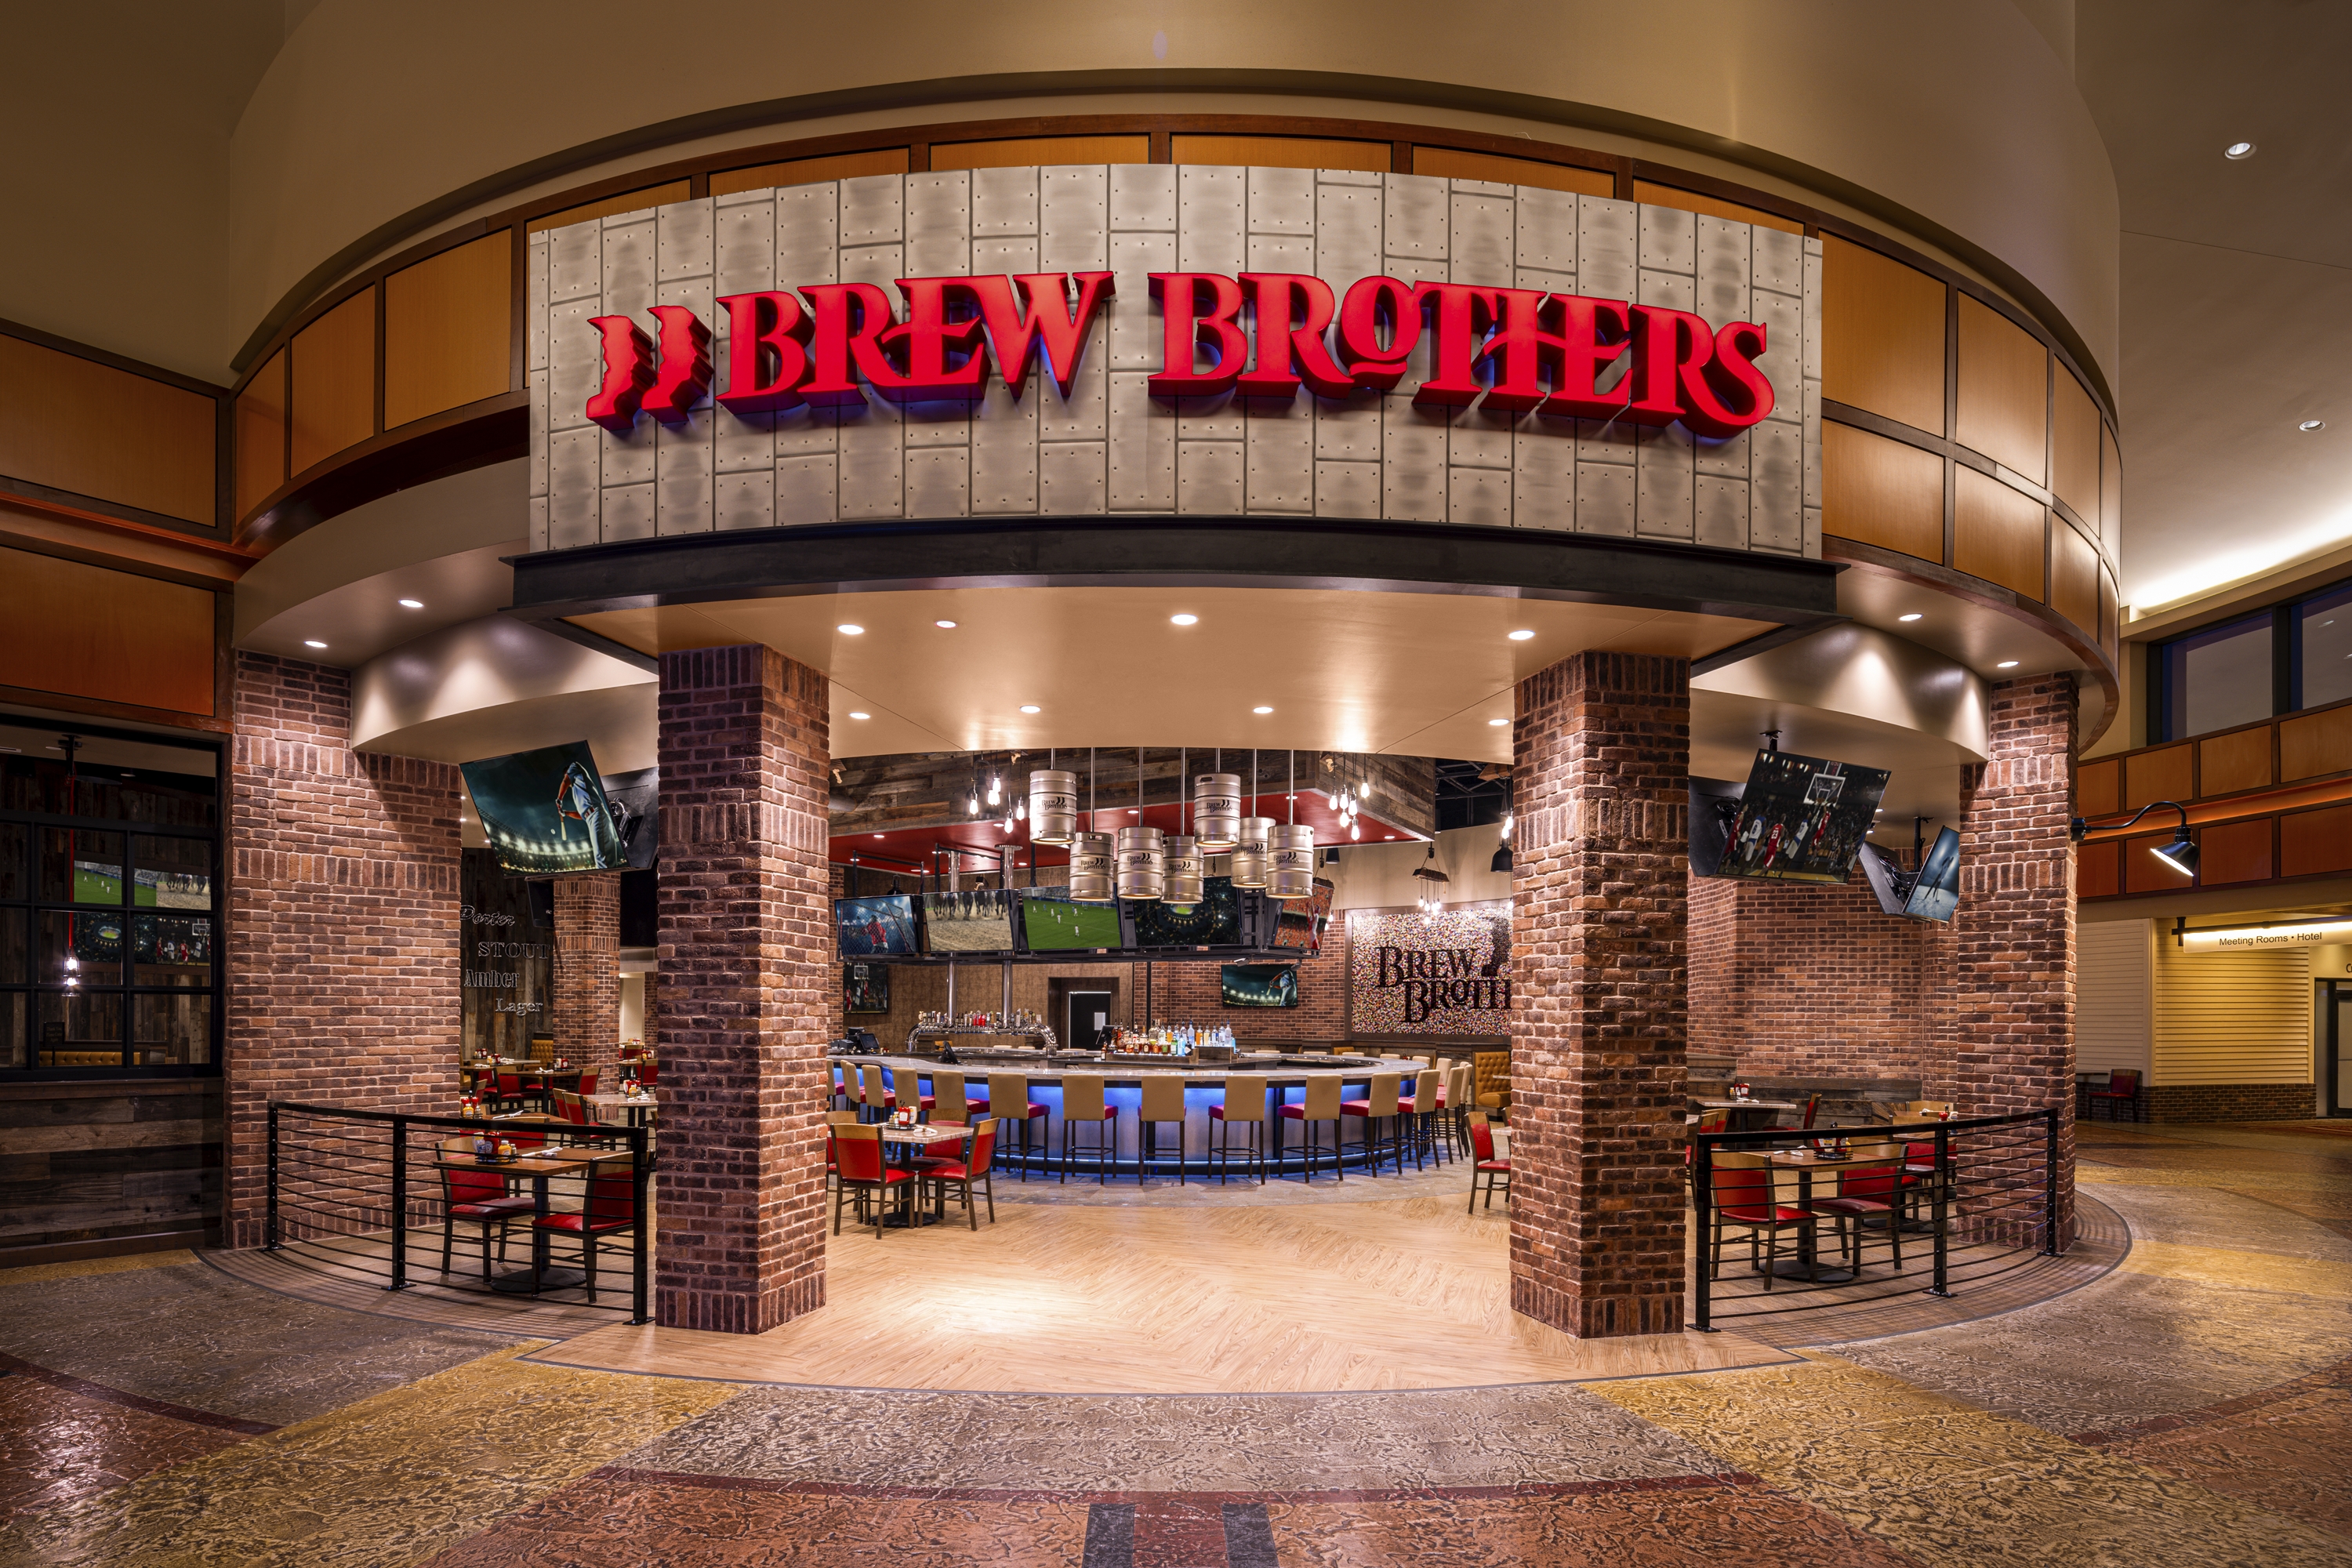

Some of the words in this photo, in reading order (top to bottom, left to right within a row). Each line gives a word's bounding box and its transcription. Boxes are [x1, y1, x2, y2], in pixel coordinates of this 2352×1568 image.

[715, 270, 1116, 413] BREW
[1147, 271, 1775, 440] BROTHERS
[2219, 937, 2253, 946] Meeting
[2297, 931, 2322, 941] Hotel
[478, 942, 550, 960] STOUT
[1374, 946, 1479, 988] BREW
[464, 969, 520, 988] Amber
[495, 998, 543, 1016] Lager
[1399, 979, 1512, 1022] BROTH
